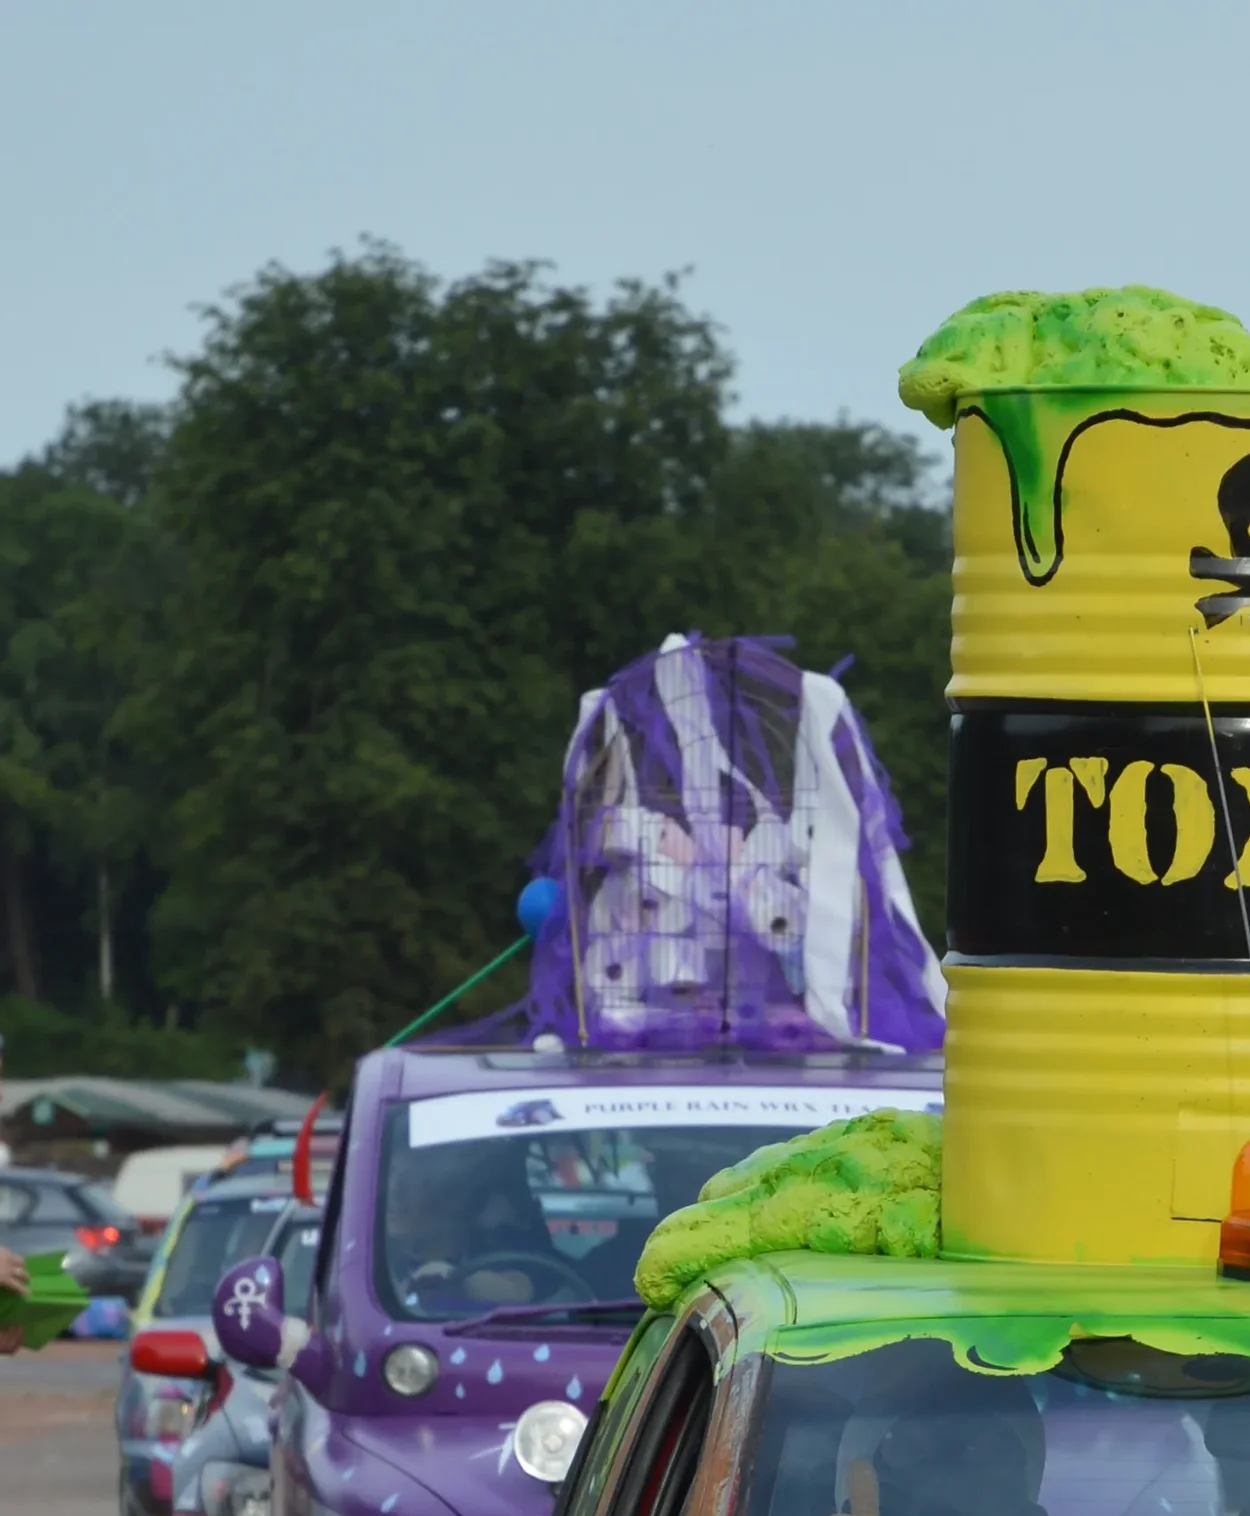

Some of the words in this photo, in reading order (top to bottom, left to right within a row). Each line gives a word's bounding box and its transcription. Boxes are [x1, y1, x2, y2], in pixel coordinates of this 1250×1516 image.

[584, 1101, 678, 1114] PURPLE
[687, 1101, 749, 1112] RAIN
[760, 1101, 818, 1113] WRX
[831, 1103, 874, 1114] TEA
